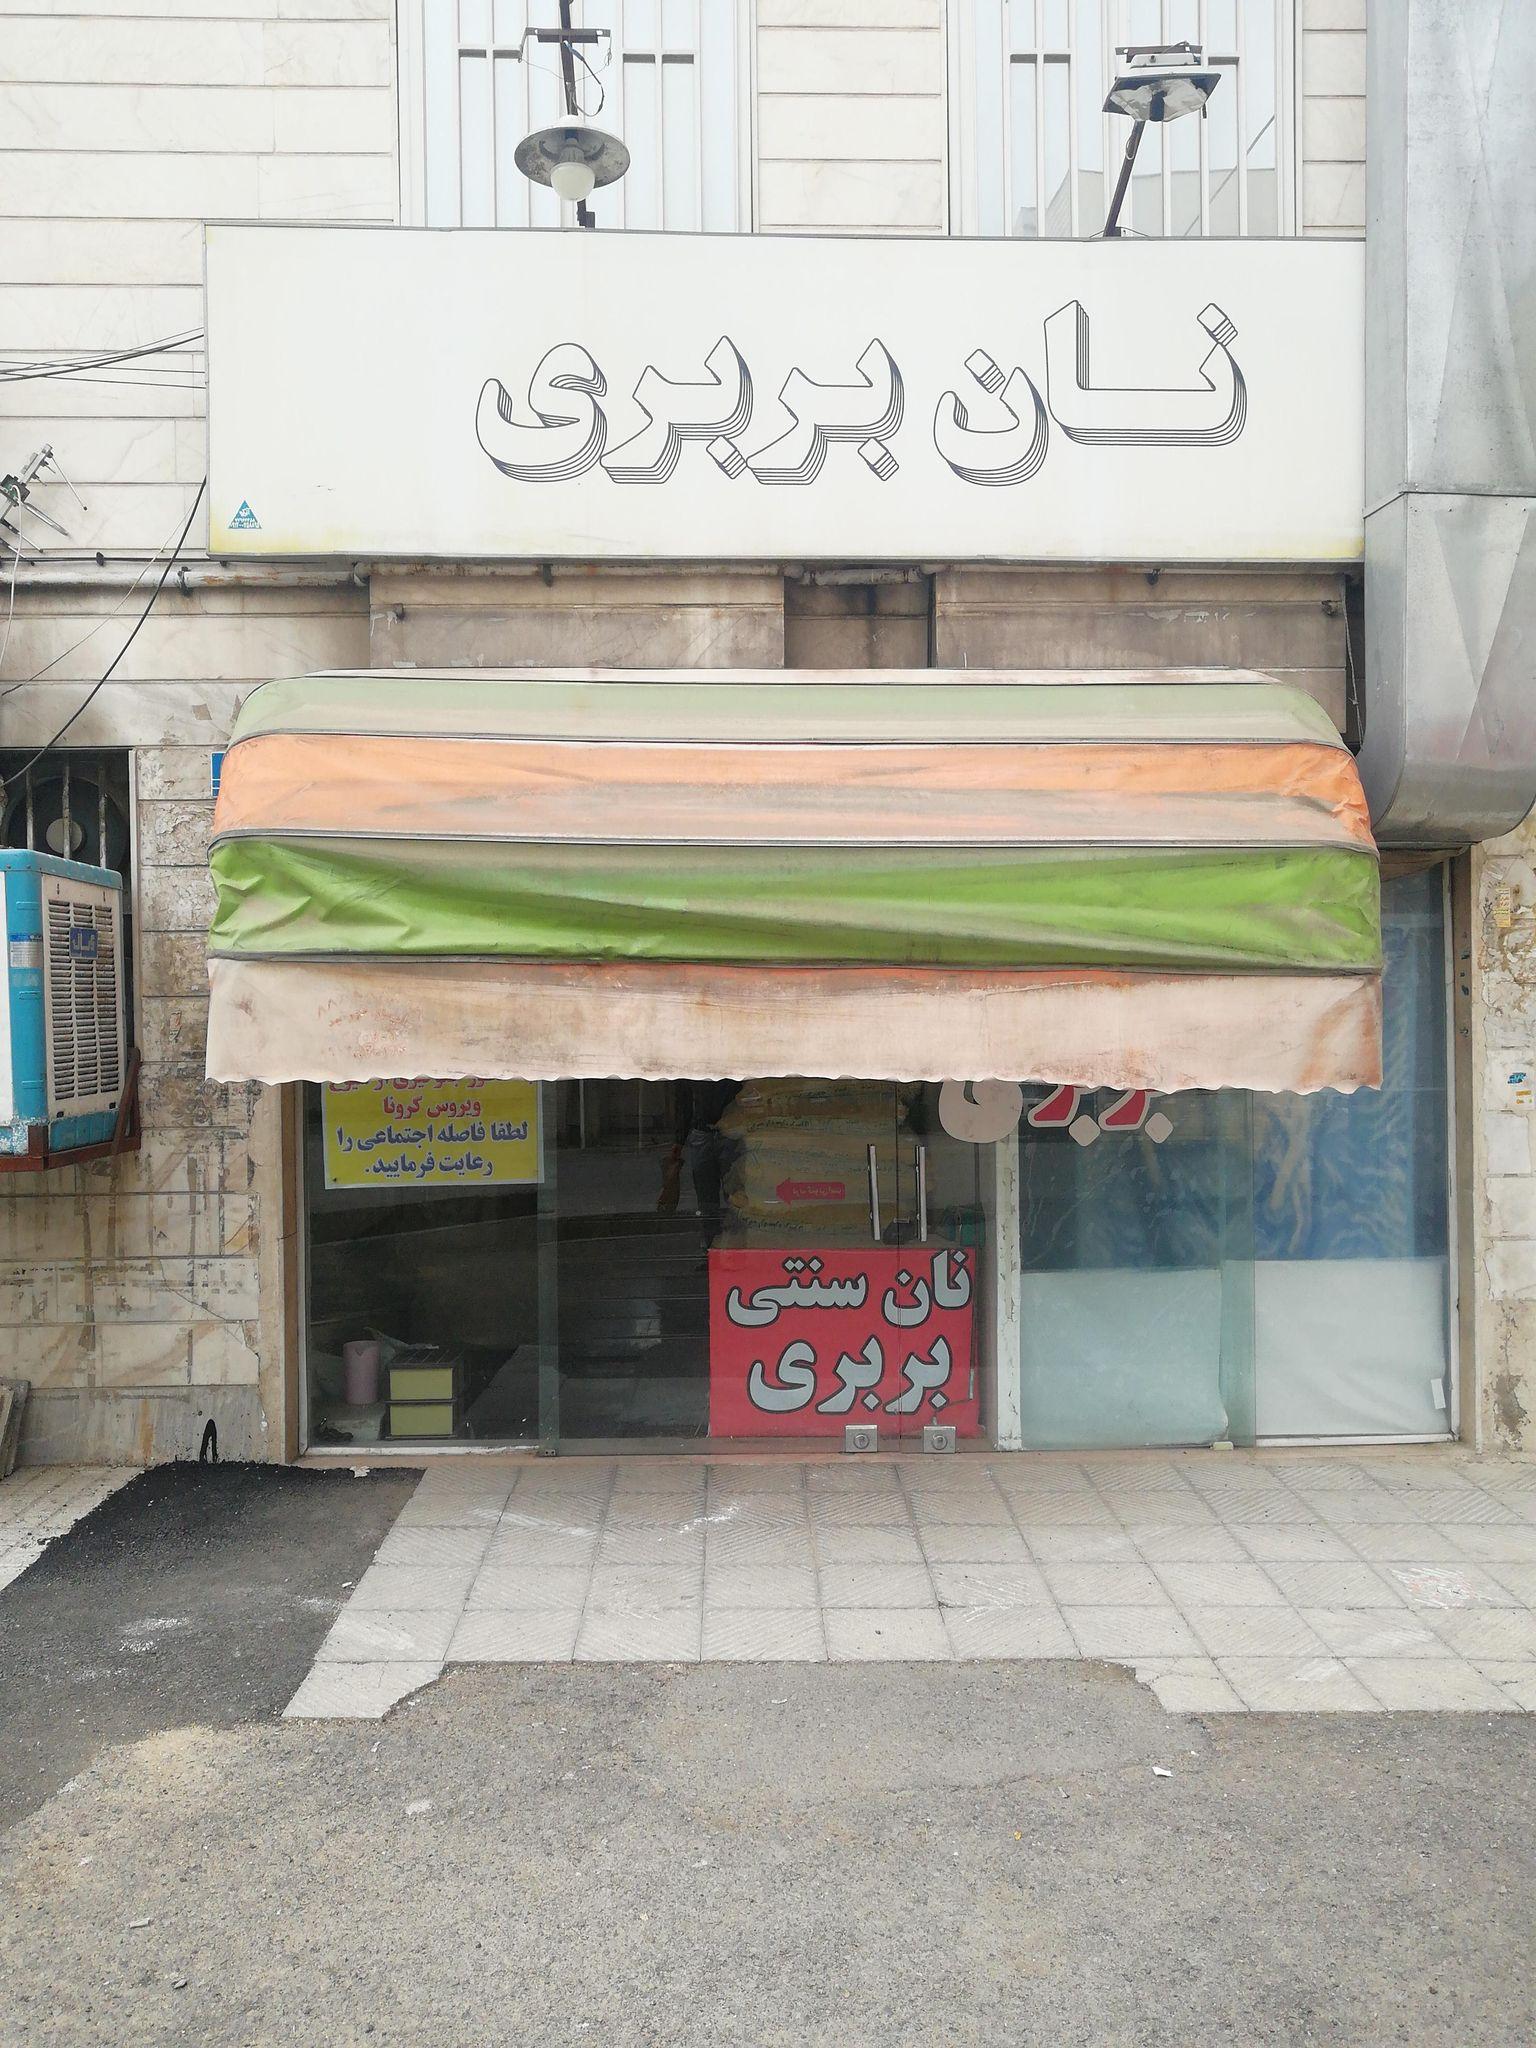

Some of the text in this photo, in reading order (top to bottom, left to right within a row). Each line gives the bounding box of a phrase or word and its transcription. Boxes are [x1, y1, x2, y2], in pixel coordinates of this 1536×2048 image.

[475, 299, 1248, 487] نان بربری
[336, 1119, 528, 1152] لطفا فاصله اجتماعی را
[383, 1095, 482, 1120] ویروس کرونا
[439, 1152, 494, 1177] رعایت
[727, 1249, 972, 1329] نان سنتی
[747, 1334, 953, 1416] بربری
